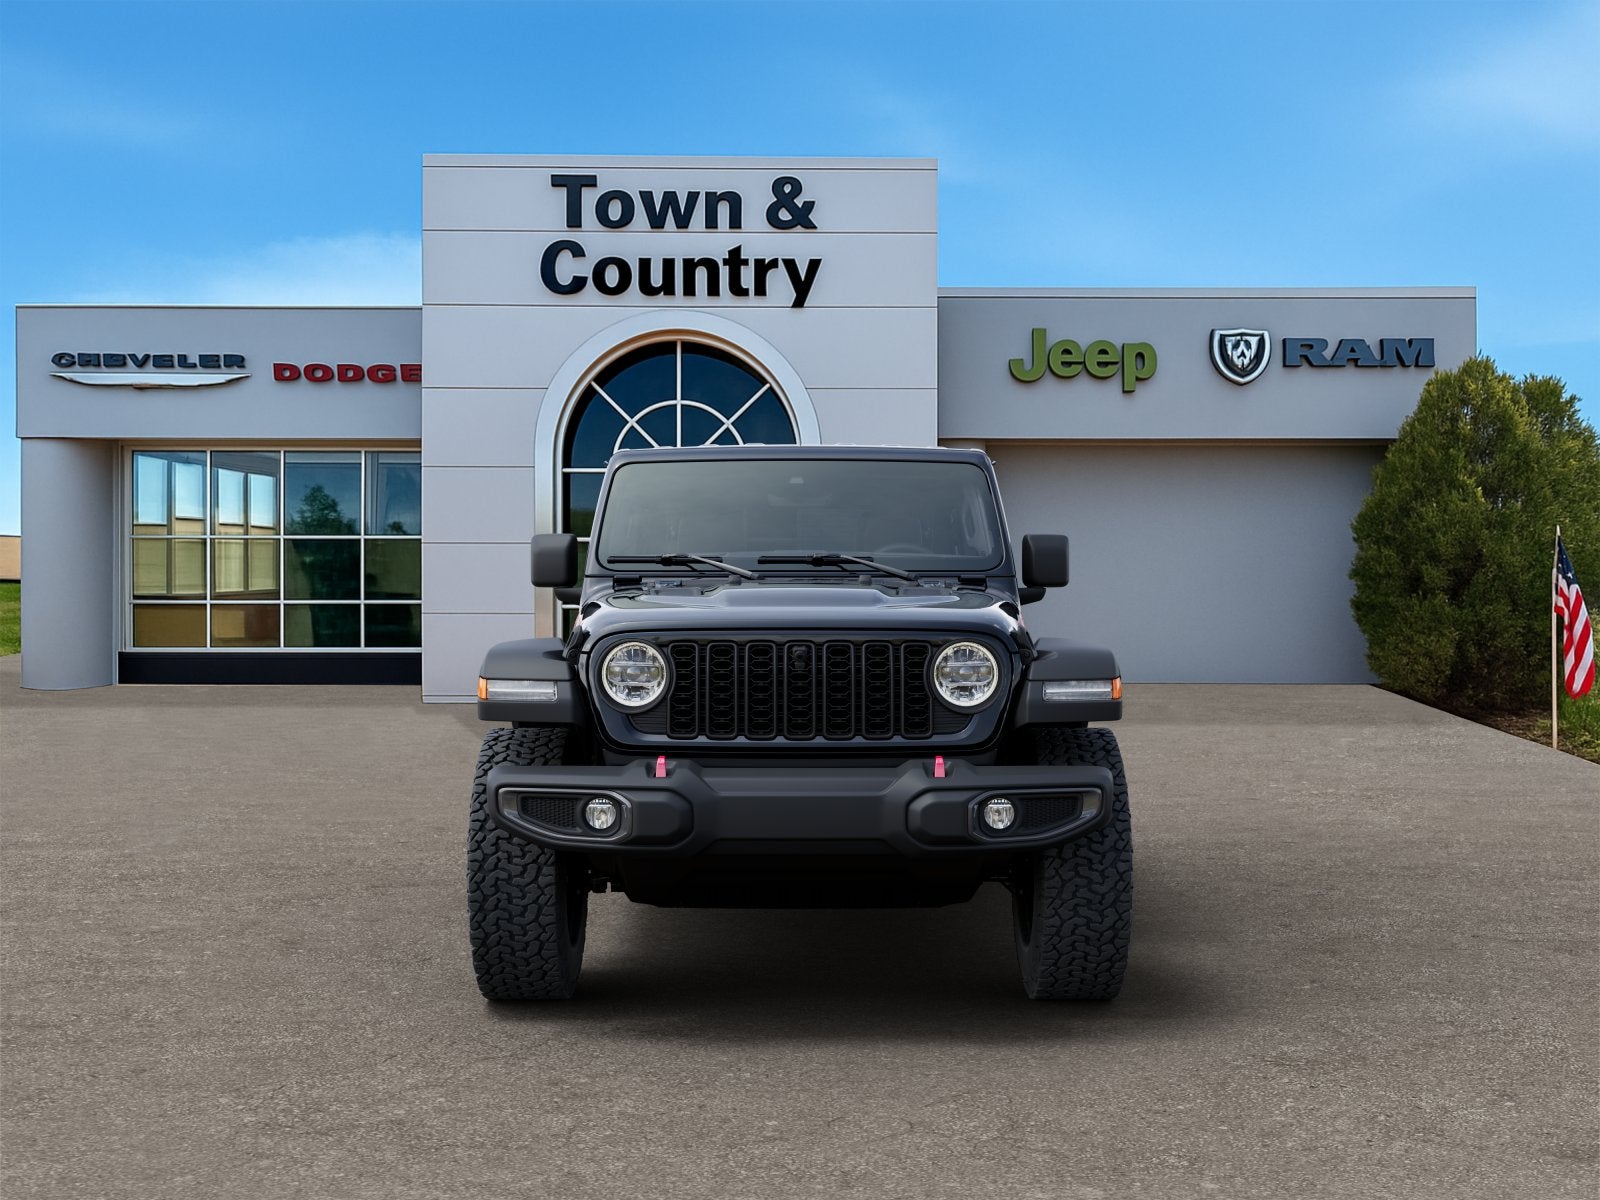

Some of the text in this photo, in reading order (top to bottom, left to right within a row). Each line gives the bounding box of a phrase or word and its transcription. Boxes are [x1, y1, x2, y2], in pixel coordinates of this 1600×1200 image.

[550, 174, 818, 230] Town &
[540, 239, 822, 308] Country
[272, 362, 422, 383] DODGE
[1008, 327, 1158, 393] Jeep
[1282, 337, 1436, 368] RAM
